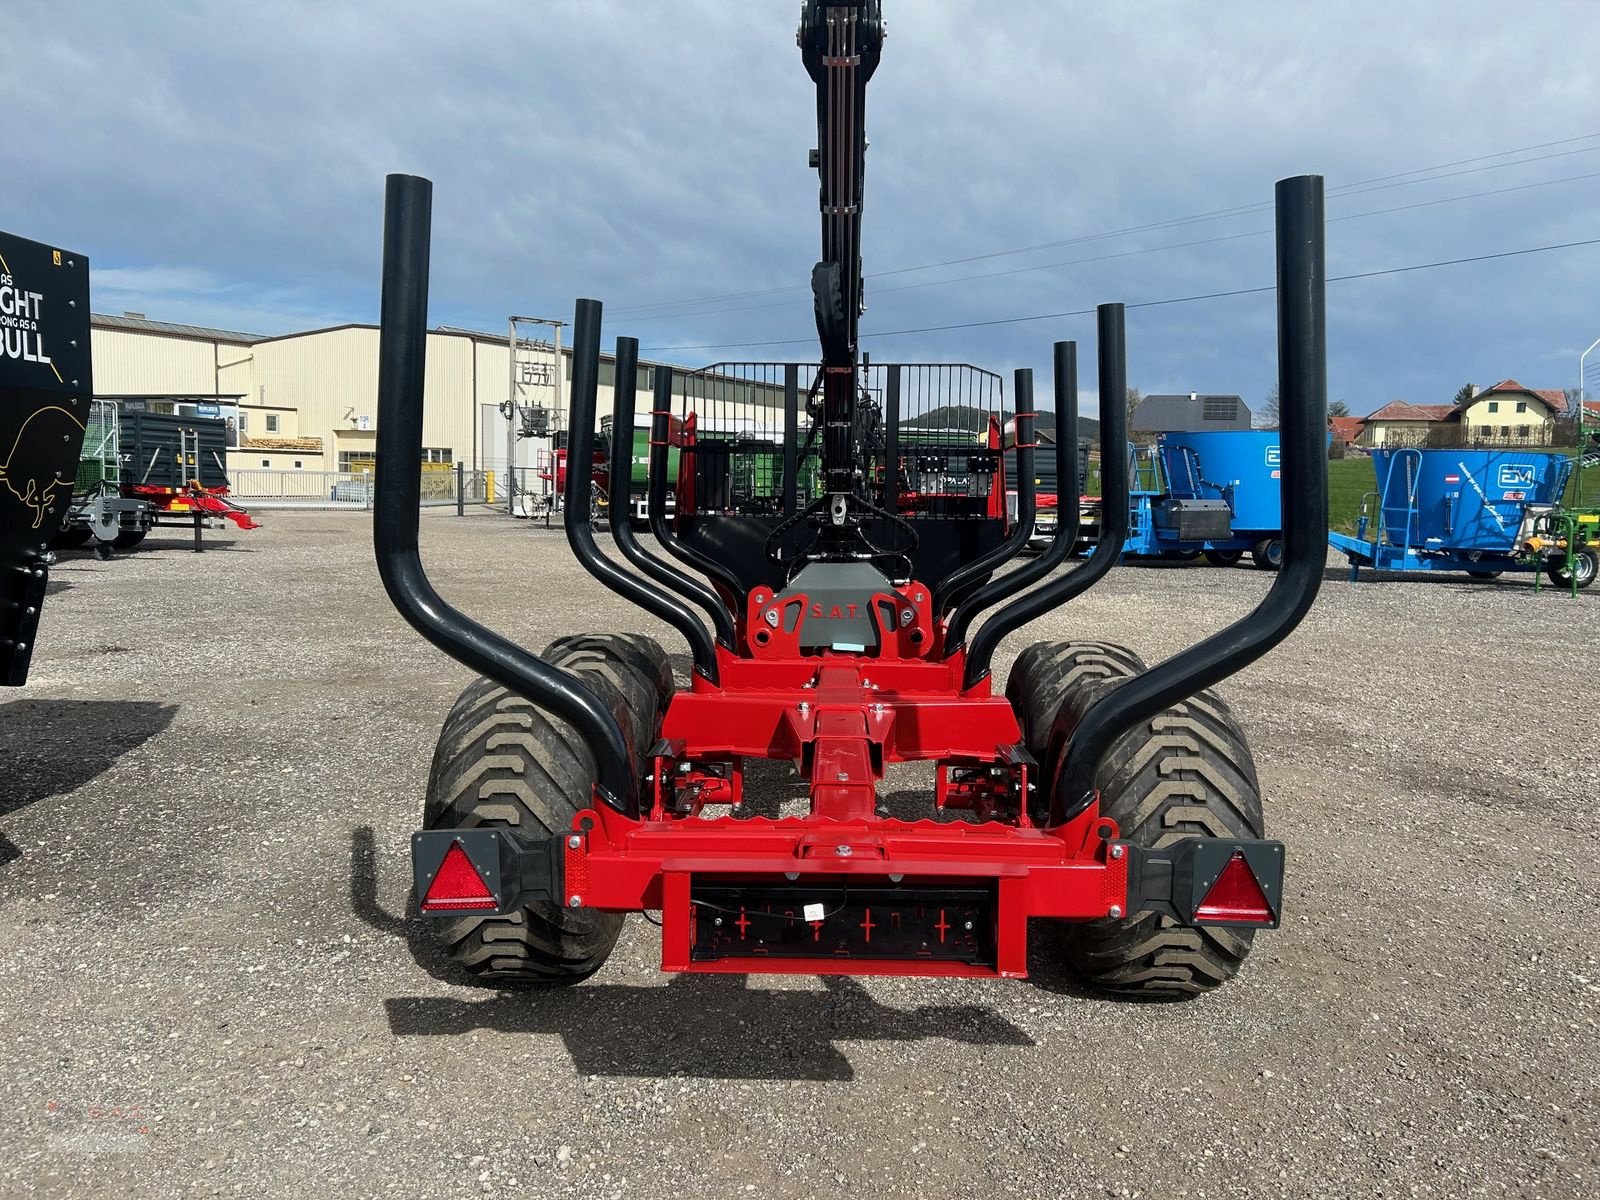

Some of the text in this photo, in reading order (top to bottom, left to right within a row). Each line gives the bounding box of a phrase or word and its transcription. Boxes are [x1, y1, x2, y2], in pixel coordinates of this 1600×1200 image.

[1, 273, 13, 286] AS
[0, 315, 37, 331] ONG AS A
